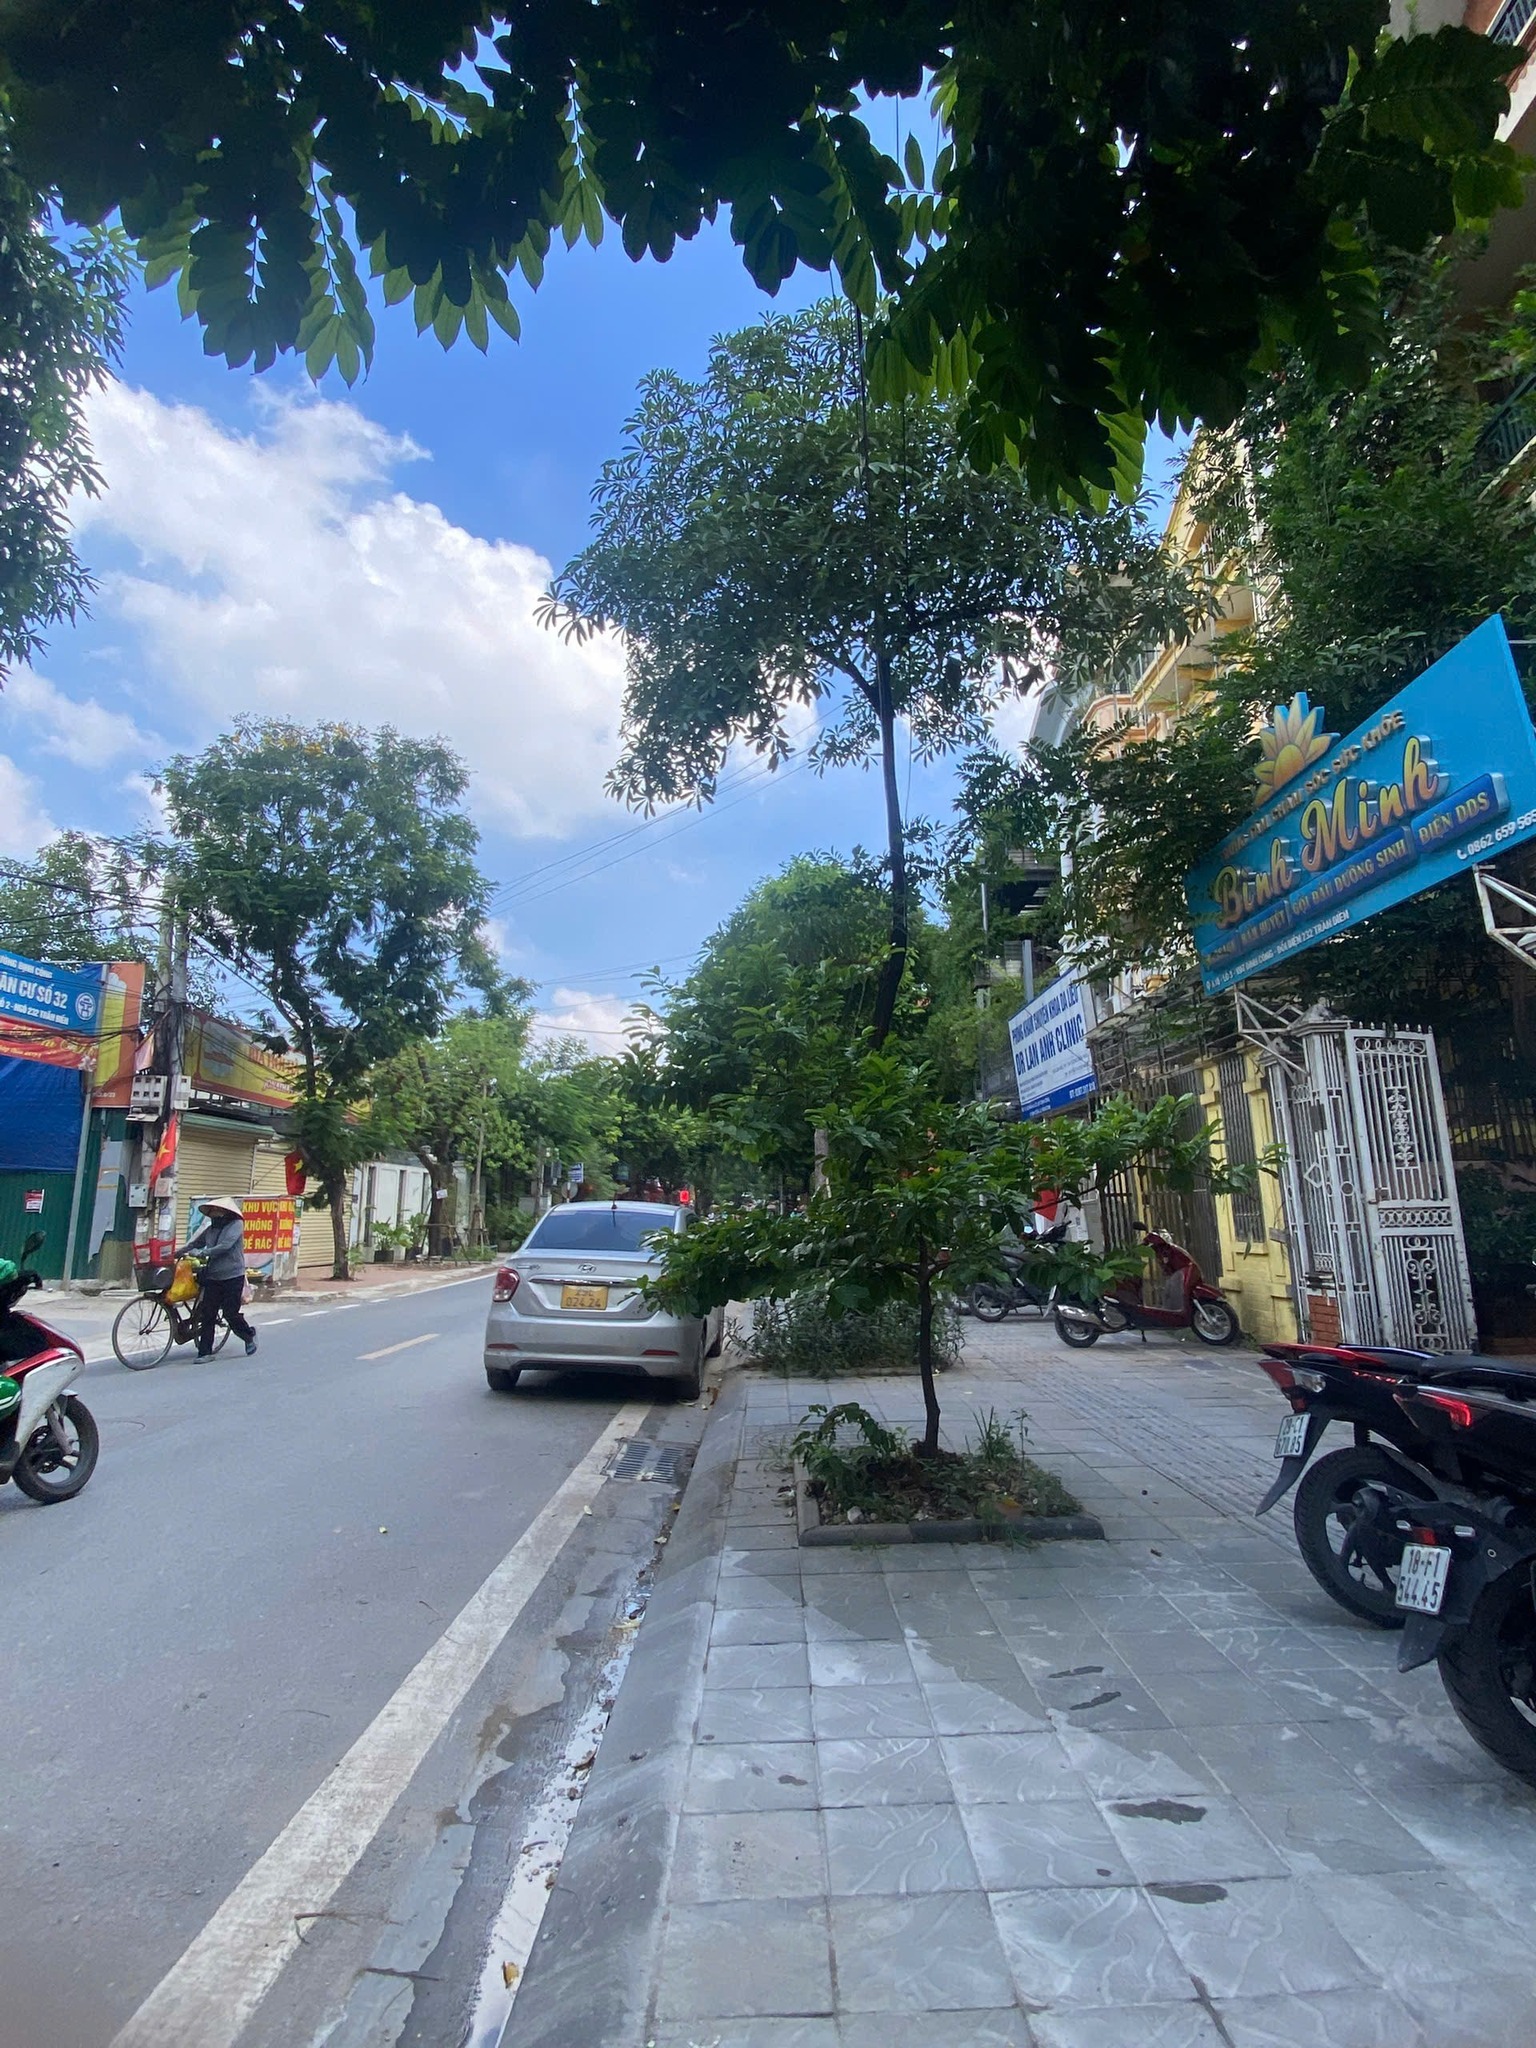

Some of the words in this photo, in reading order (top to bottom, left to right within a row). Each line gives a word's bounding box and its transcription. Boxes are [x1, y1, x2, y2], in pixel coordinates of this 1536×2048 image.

[1454, 791, 1490, 819] DDS
[1214, 838, 1295, 930] Bình
[1300, 735, 1442, 873] Minh
[1467, 833, 1494, 855] 0862
[1495, 821, 1516, 842] 659
[1375, 838, 1407, 870] SINH
[19, 980, 38, 999] CƯ
[37, 983, 55, 1005] SỐ
[54, 991, 68, 1009] 32
[27, 1007, 40, 1017] 232
[1015, 1051, 1026, 1076] DR
[1025, 1041, 1040, 1071] LAN
[1039, 1031, 1056, 1063] ANH
[1055, 1013, 1085, 1053] CLINIC
[242, 1201, 260, 1213] KHU
[261, 1201, 278, 1215] VỰC
[244, 1218, 273, 1231] KHÔNG
[254, 1236, 272, 1250] RÁC
[1408, 1549, 1441, 1579] 18-F1
[1398, 1576, 1441, 1609] 544.45
